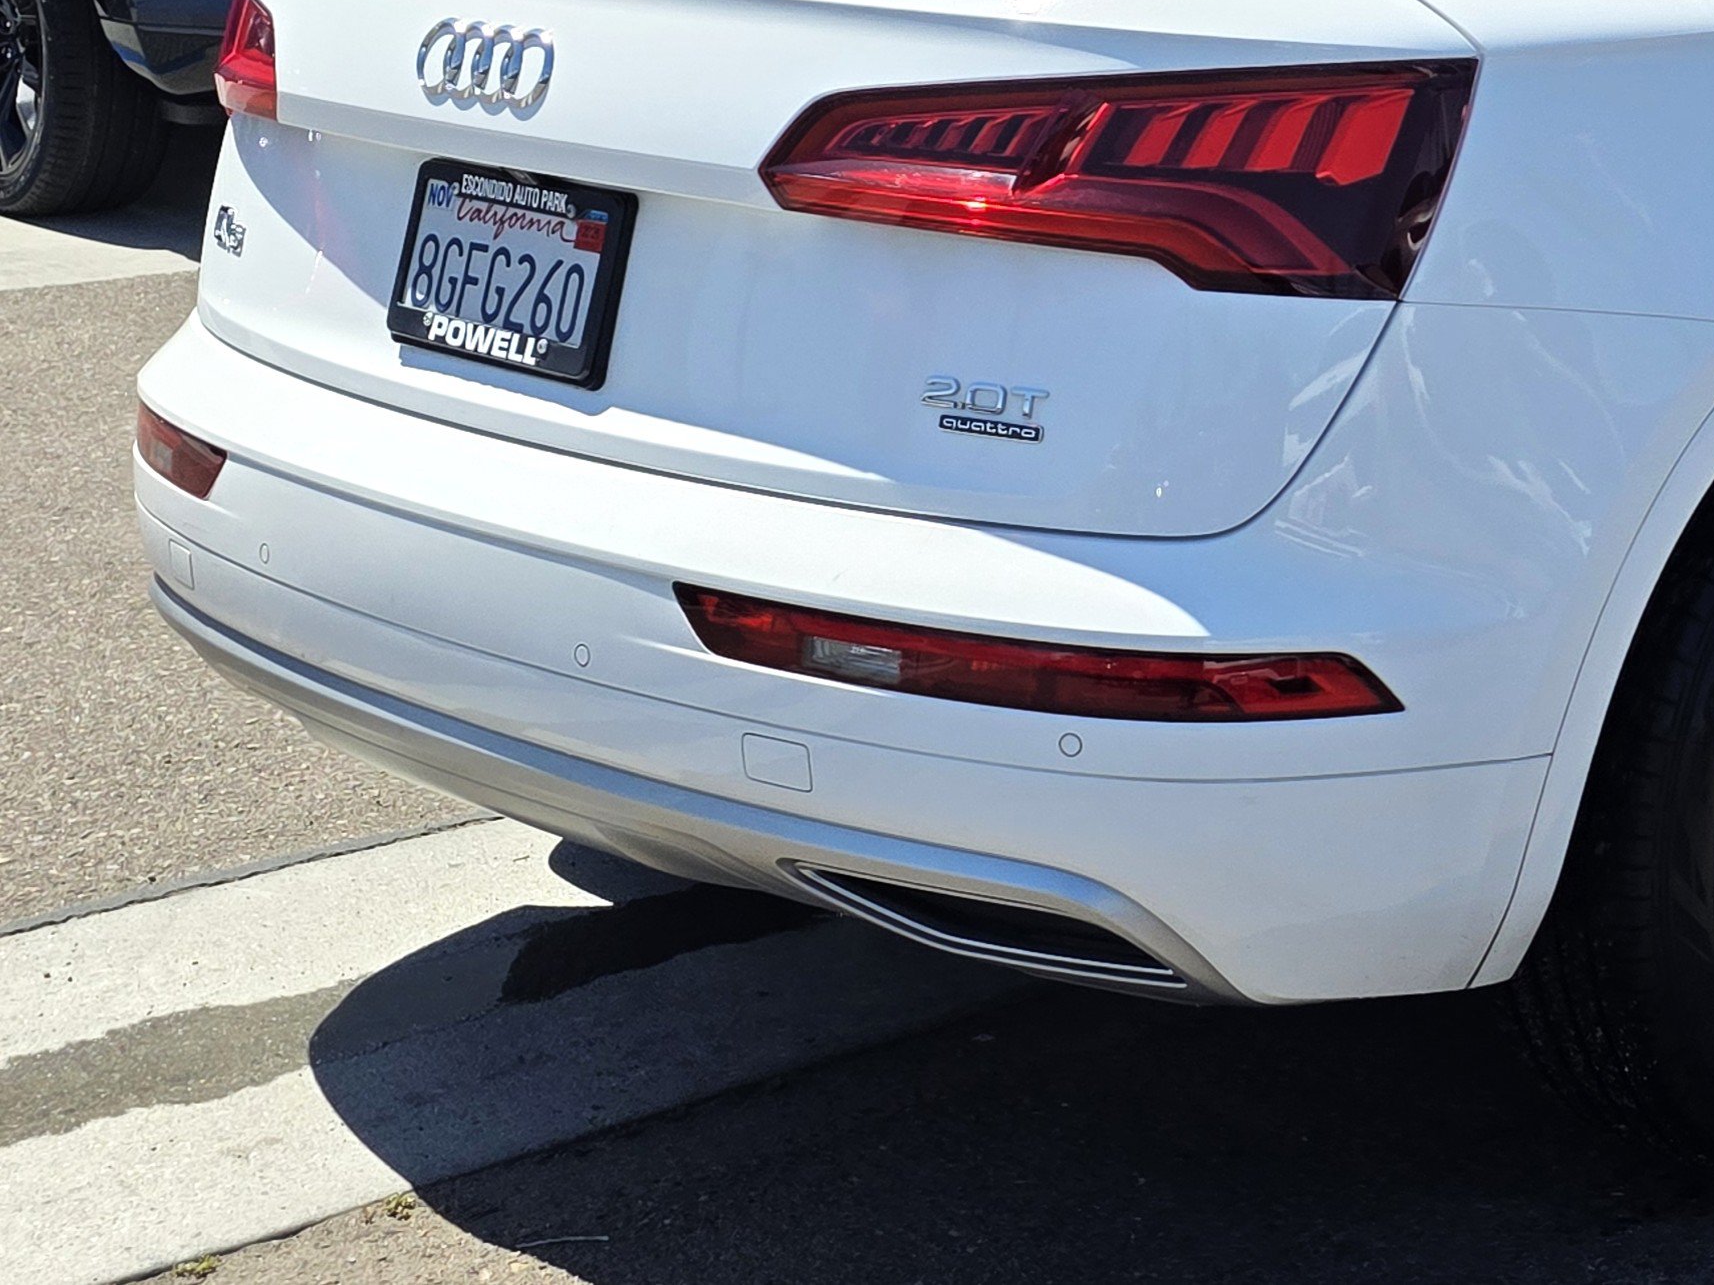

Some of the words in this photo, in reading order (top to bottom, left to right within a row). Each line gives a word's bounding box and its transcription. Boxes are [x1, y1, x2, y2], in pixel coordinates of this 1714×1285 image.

[428, 183, 454, 208] NOV
[461, 174, 513, 203] ESCONDIDO
[513, 187, 540, 207] AUTO
[541, 190, 568, 213] PARK
[456, 196, 575, 242] California
[411, 233, 585, 342] 8GFG260
[428, 316, 537, 366] POWELL
[920, 375, 1050, 419] 2.0T
[942, 417, 1036, 438] quattro
